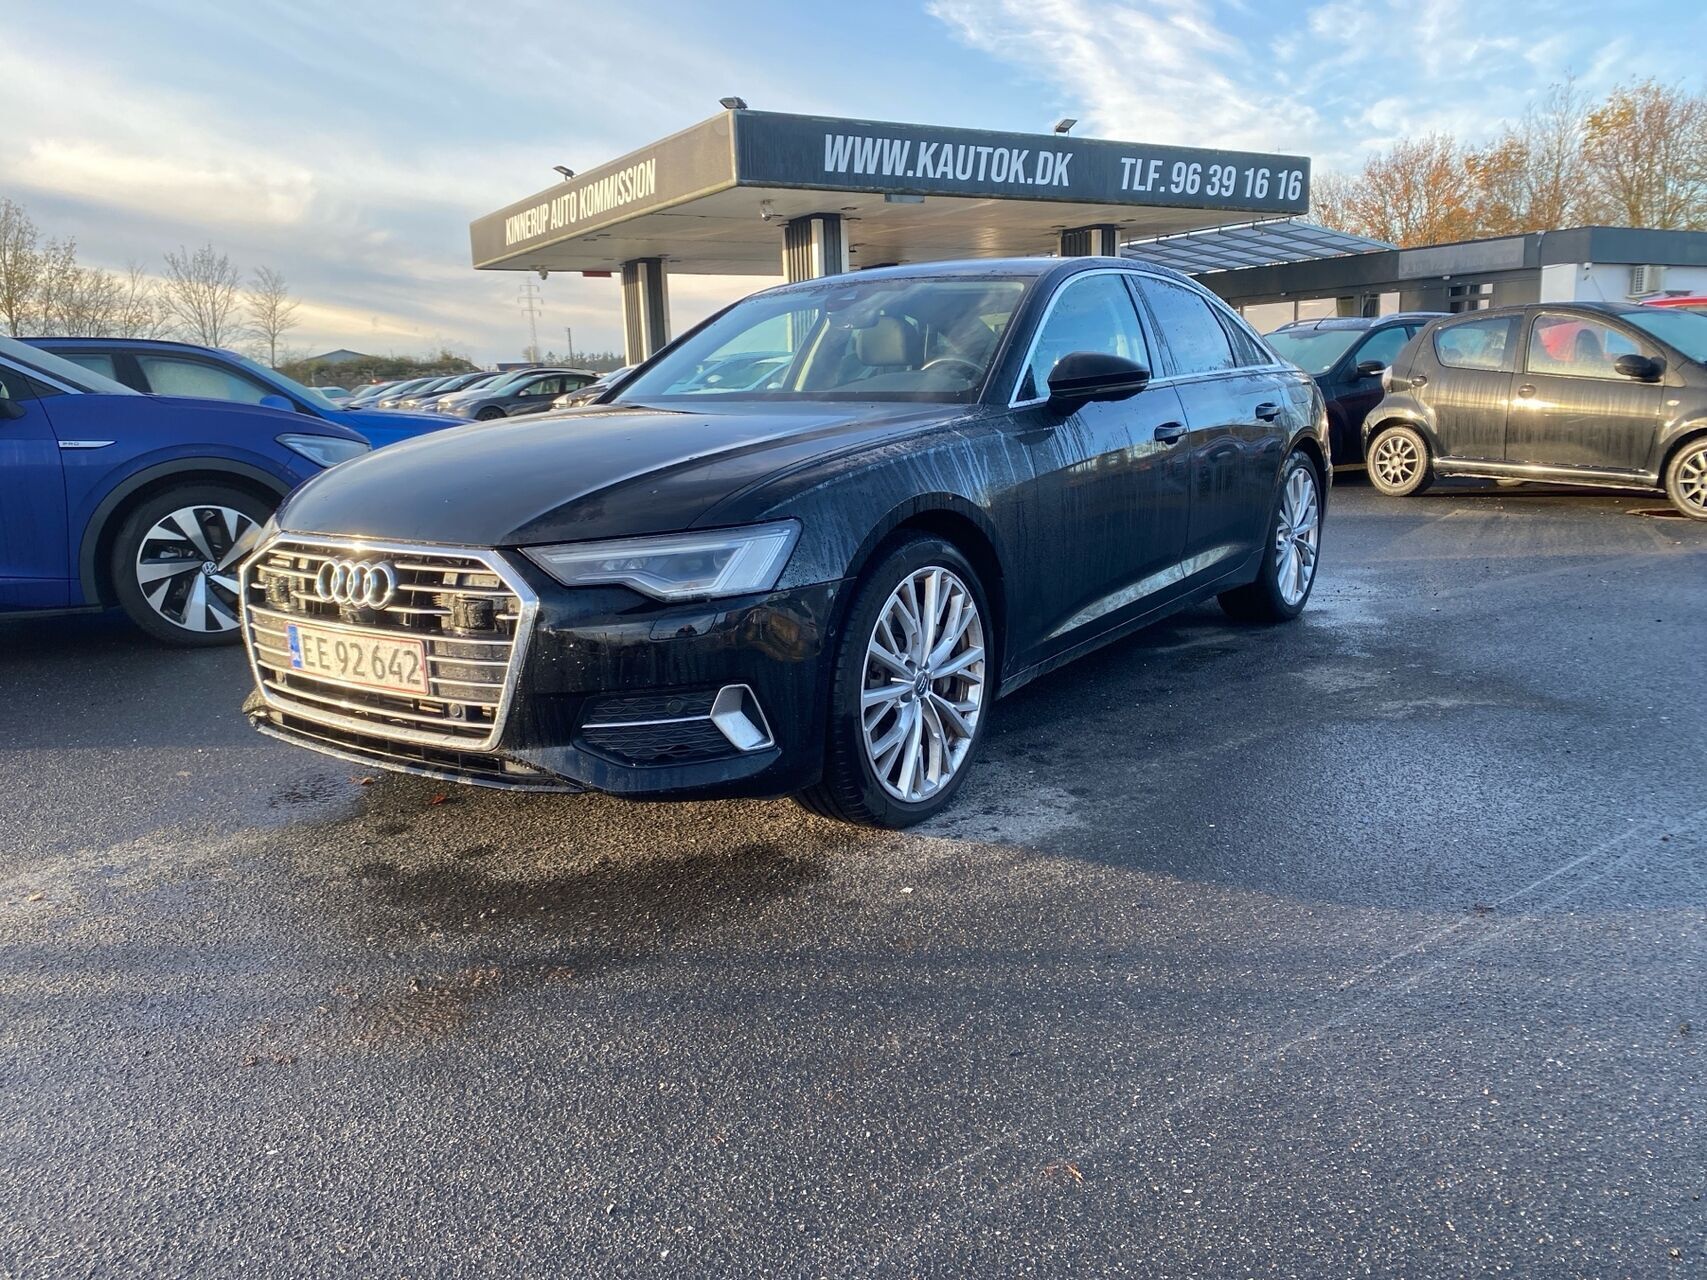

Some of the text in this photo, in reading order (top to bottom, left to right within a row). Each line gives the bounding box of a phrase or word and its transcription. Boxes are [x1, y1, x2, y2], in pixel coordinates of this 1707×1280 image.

[824, 133, 1074, 187] WWW.KAUTOK.DK
[1121, 157, 1303, 201] TLF. 96 39 16 16
[505, 158, 656, 246] KINNERUP AUTO KOMMISSION
